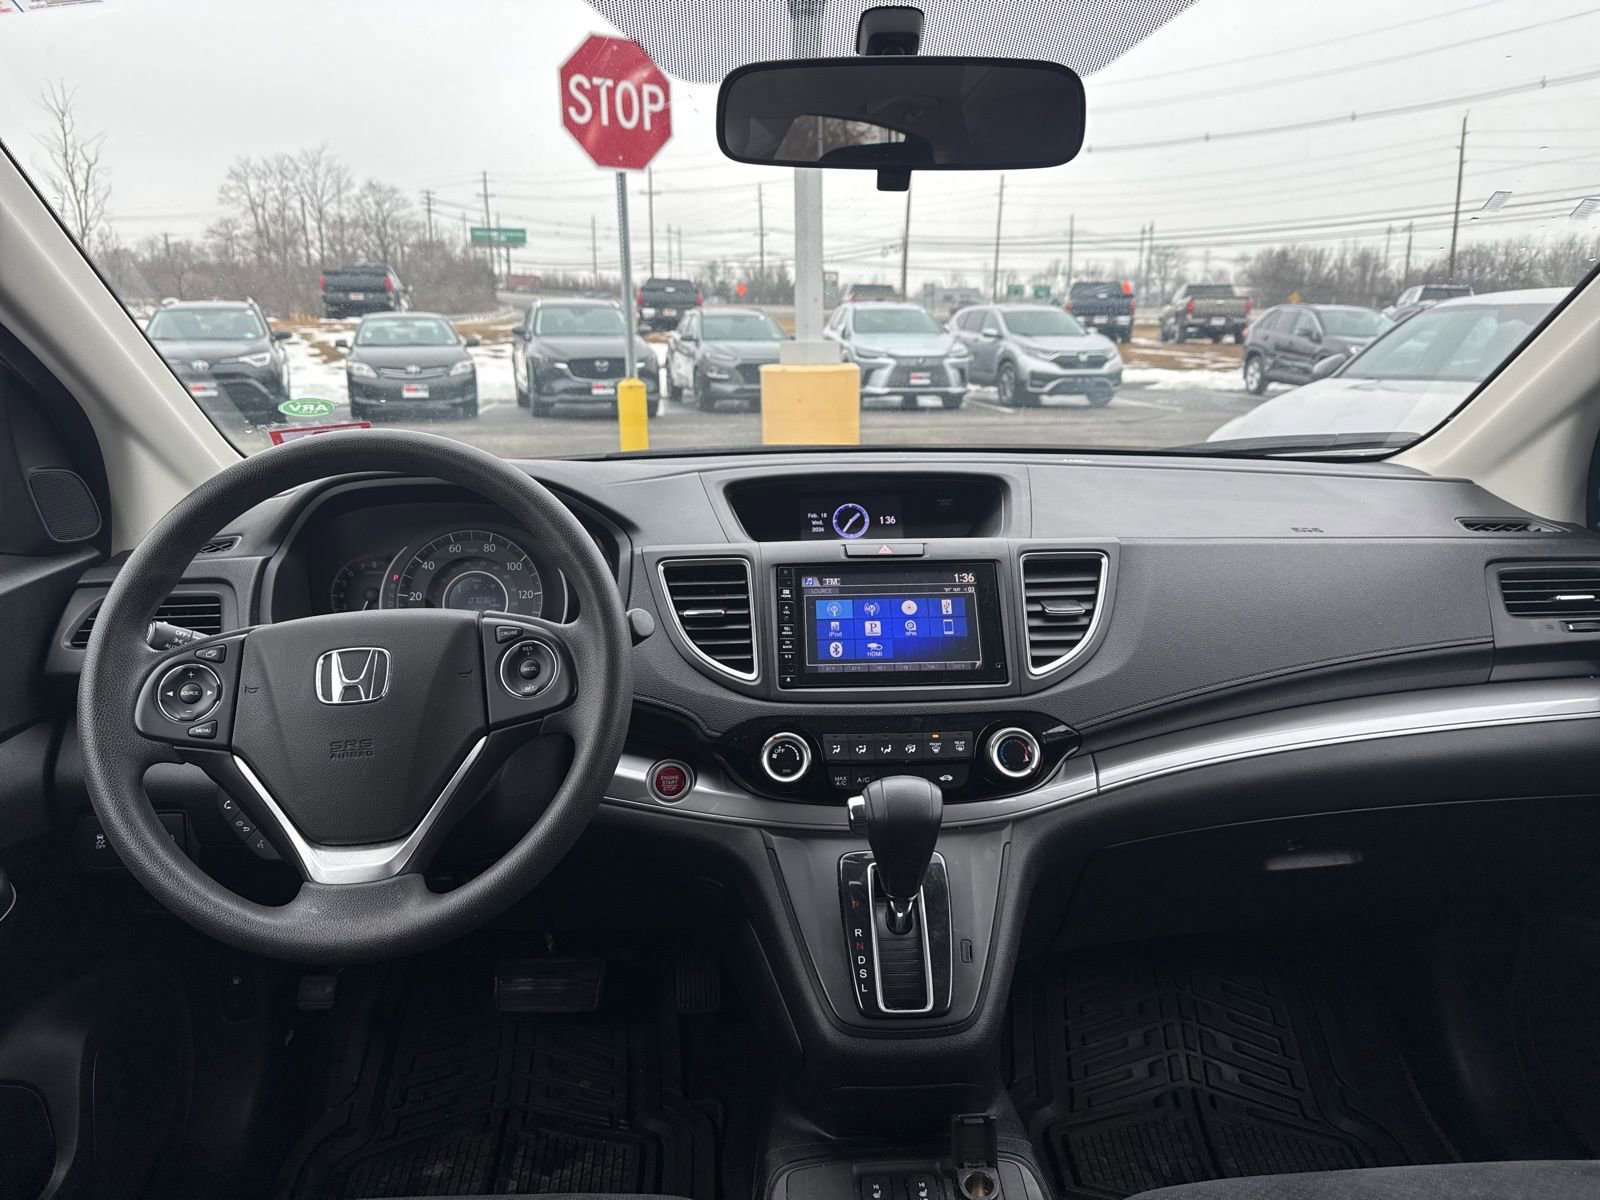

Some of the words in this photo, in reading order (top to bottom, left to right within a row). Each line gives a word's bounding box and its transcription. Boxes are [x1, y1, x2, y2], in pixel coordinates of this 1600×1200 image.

[568, 73, 665, 131] STOP
[448, 543, 462, 553] 60
[483, 543, 496, 553] 80
[421, 560, 435, 571] 40
[506, 561, 522, 571] 100
[953, 572, 975, 583] 1:36
[409, 591, 423, 602] 20
[518, 590, 534, 600] 120
[175, 629, 188, 638] OFF
[500, 629, 518, 637] CRUISE
[329, 738, 373, 750] SRS
[854, 928, 863, 937] R
[856, 942, 864, 950] N
[857, 955, 866, 965] D
[859, 969, 868, 979] S
[861, 983, 868, 992] L
